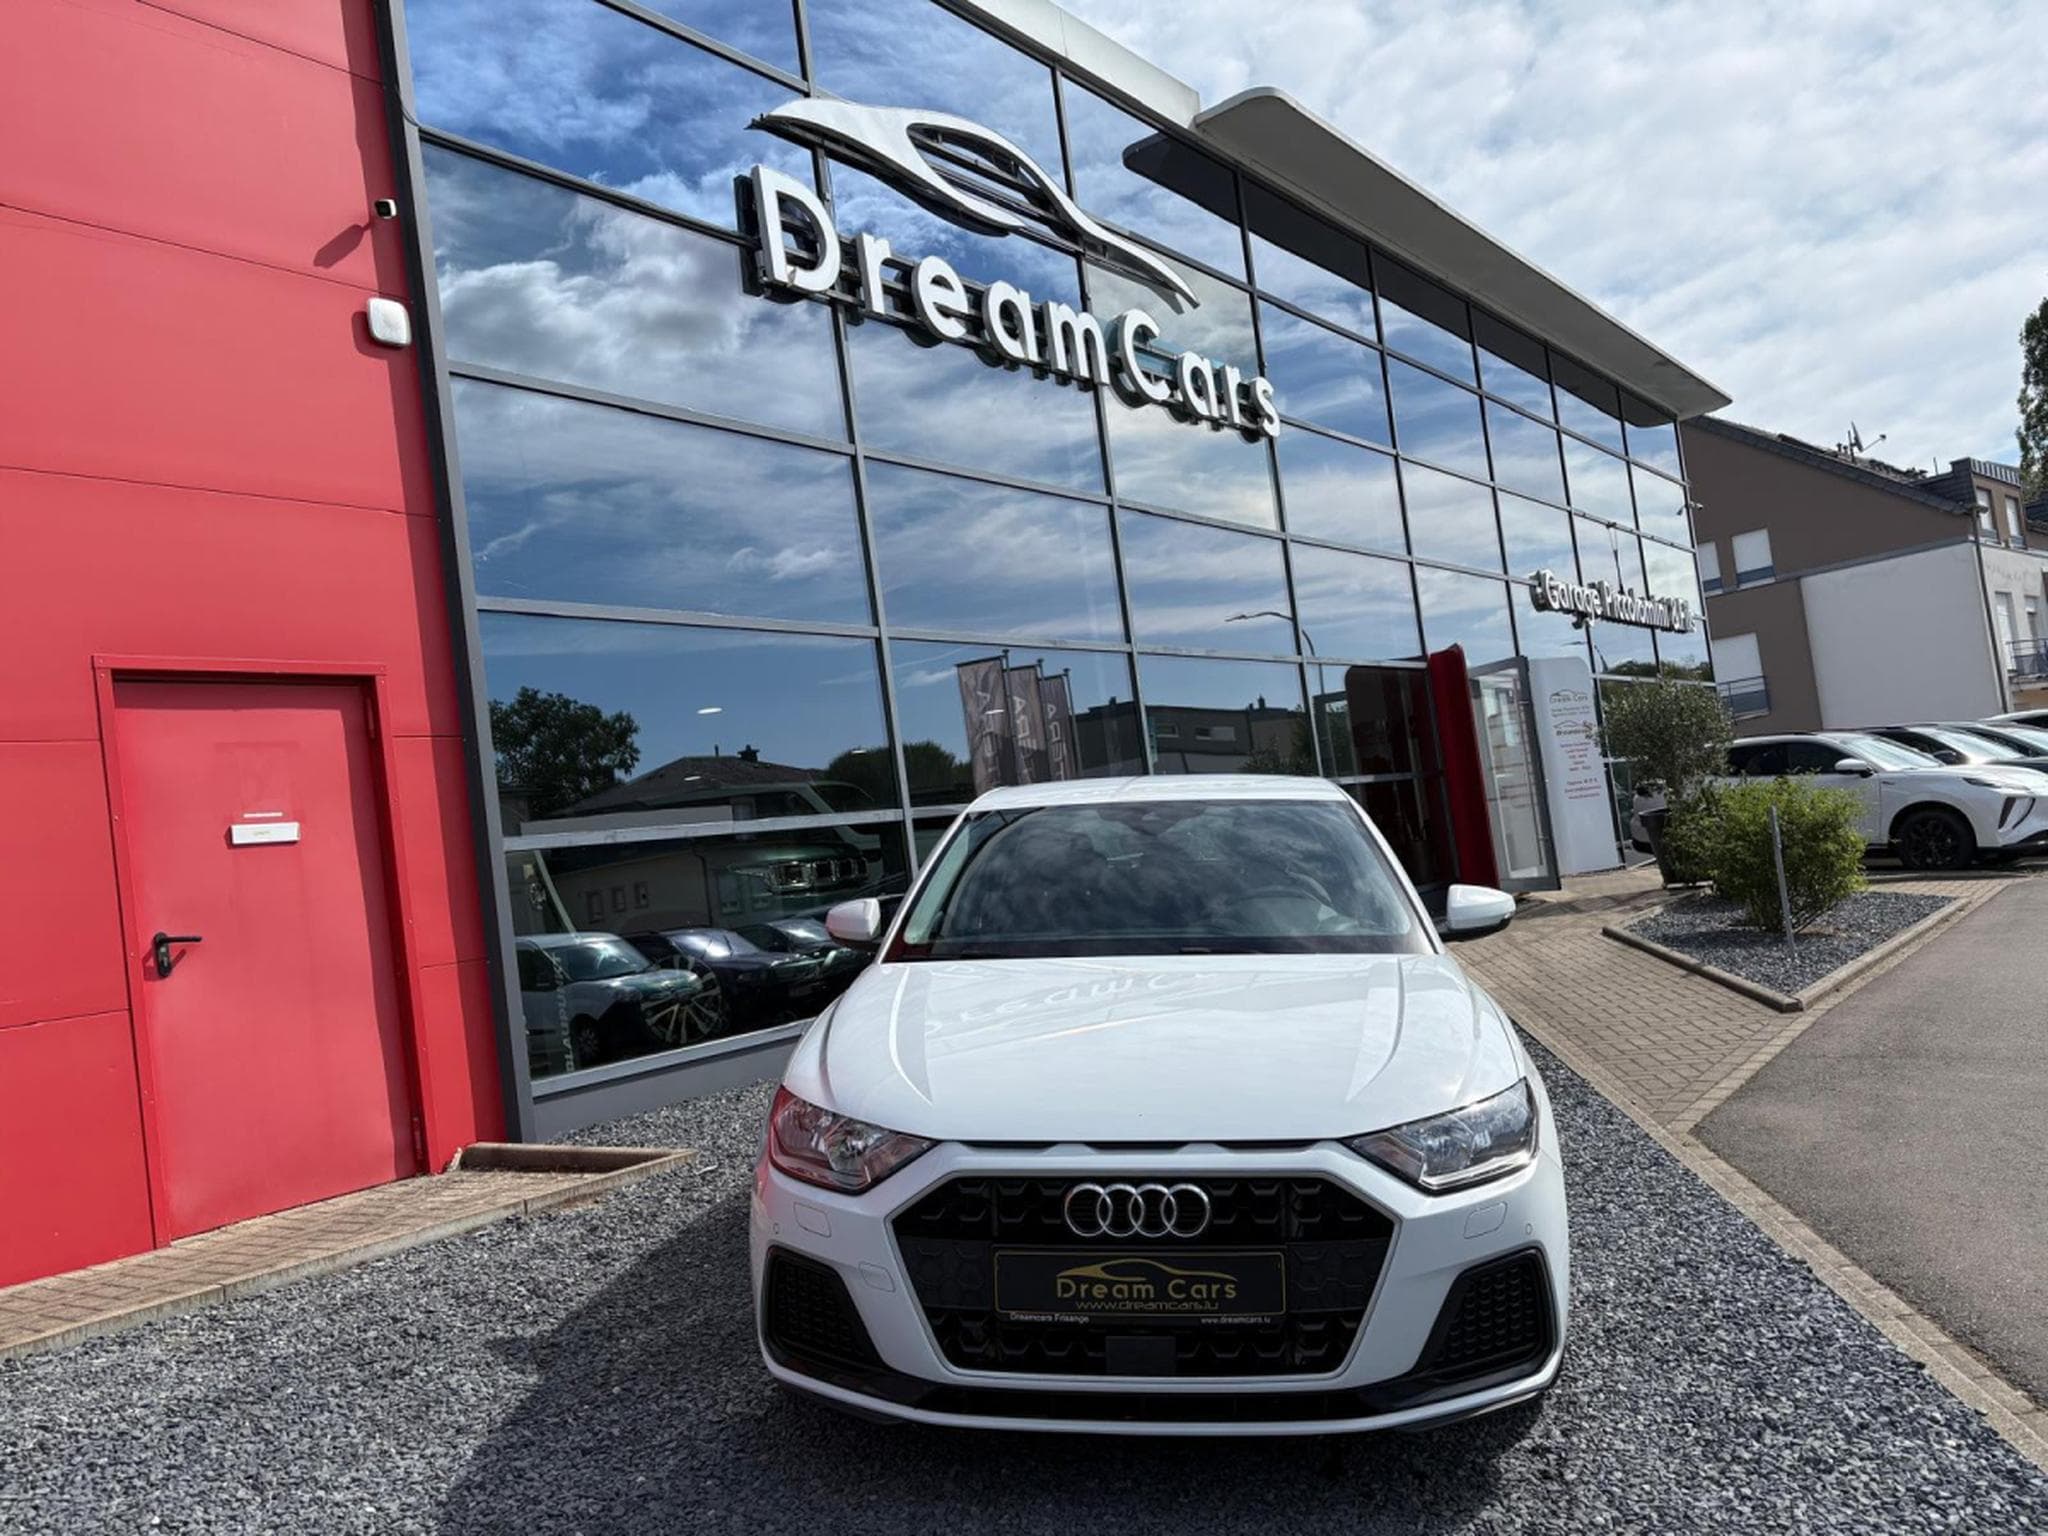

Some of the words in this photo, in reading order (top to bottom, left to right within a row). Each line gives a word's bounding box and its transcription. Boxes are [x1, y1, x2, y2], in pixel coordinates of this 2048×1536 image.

[1056, 1278, 1155, 1299] Dream
[1167, 1278, 1238, 1299] Cars
[1075, 1299, 1219, 1311] www.dreamcars.lu
